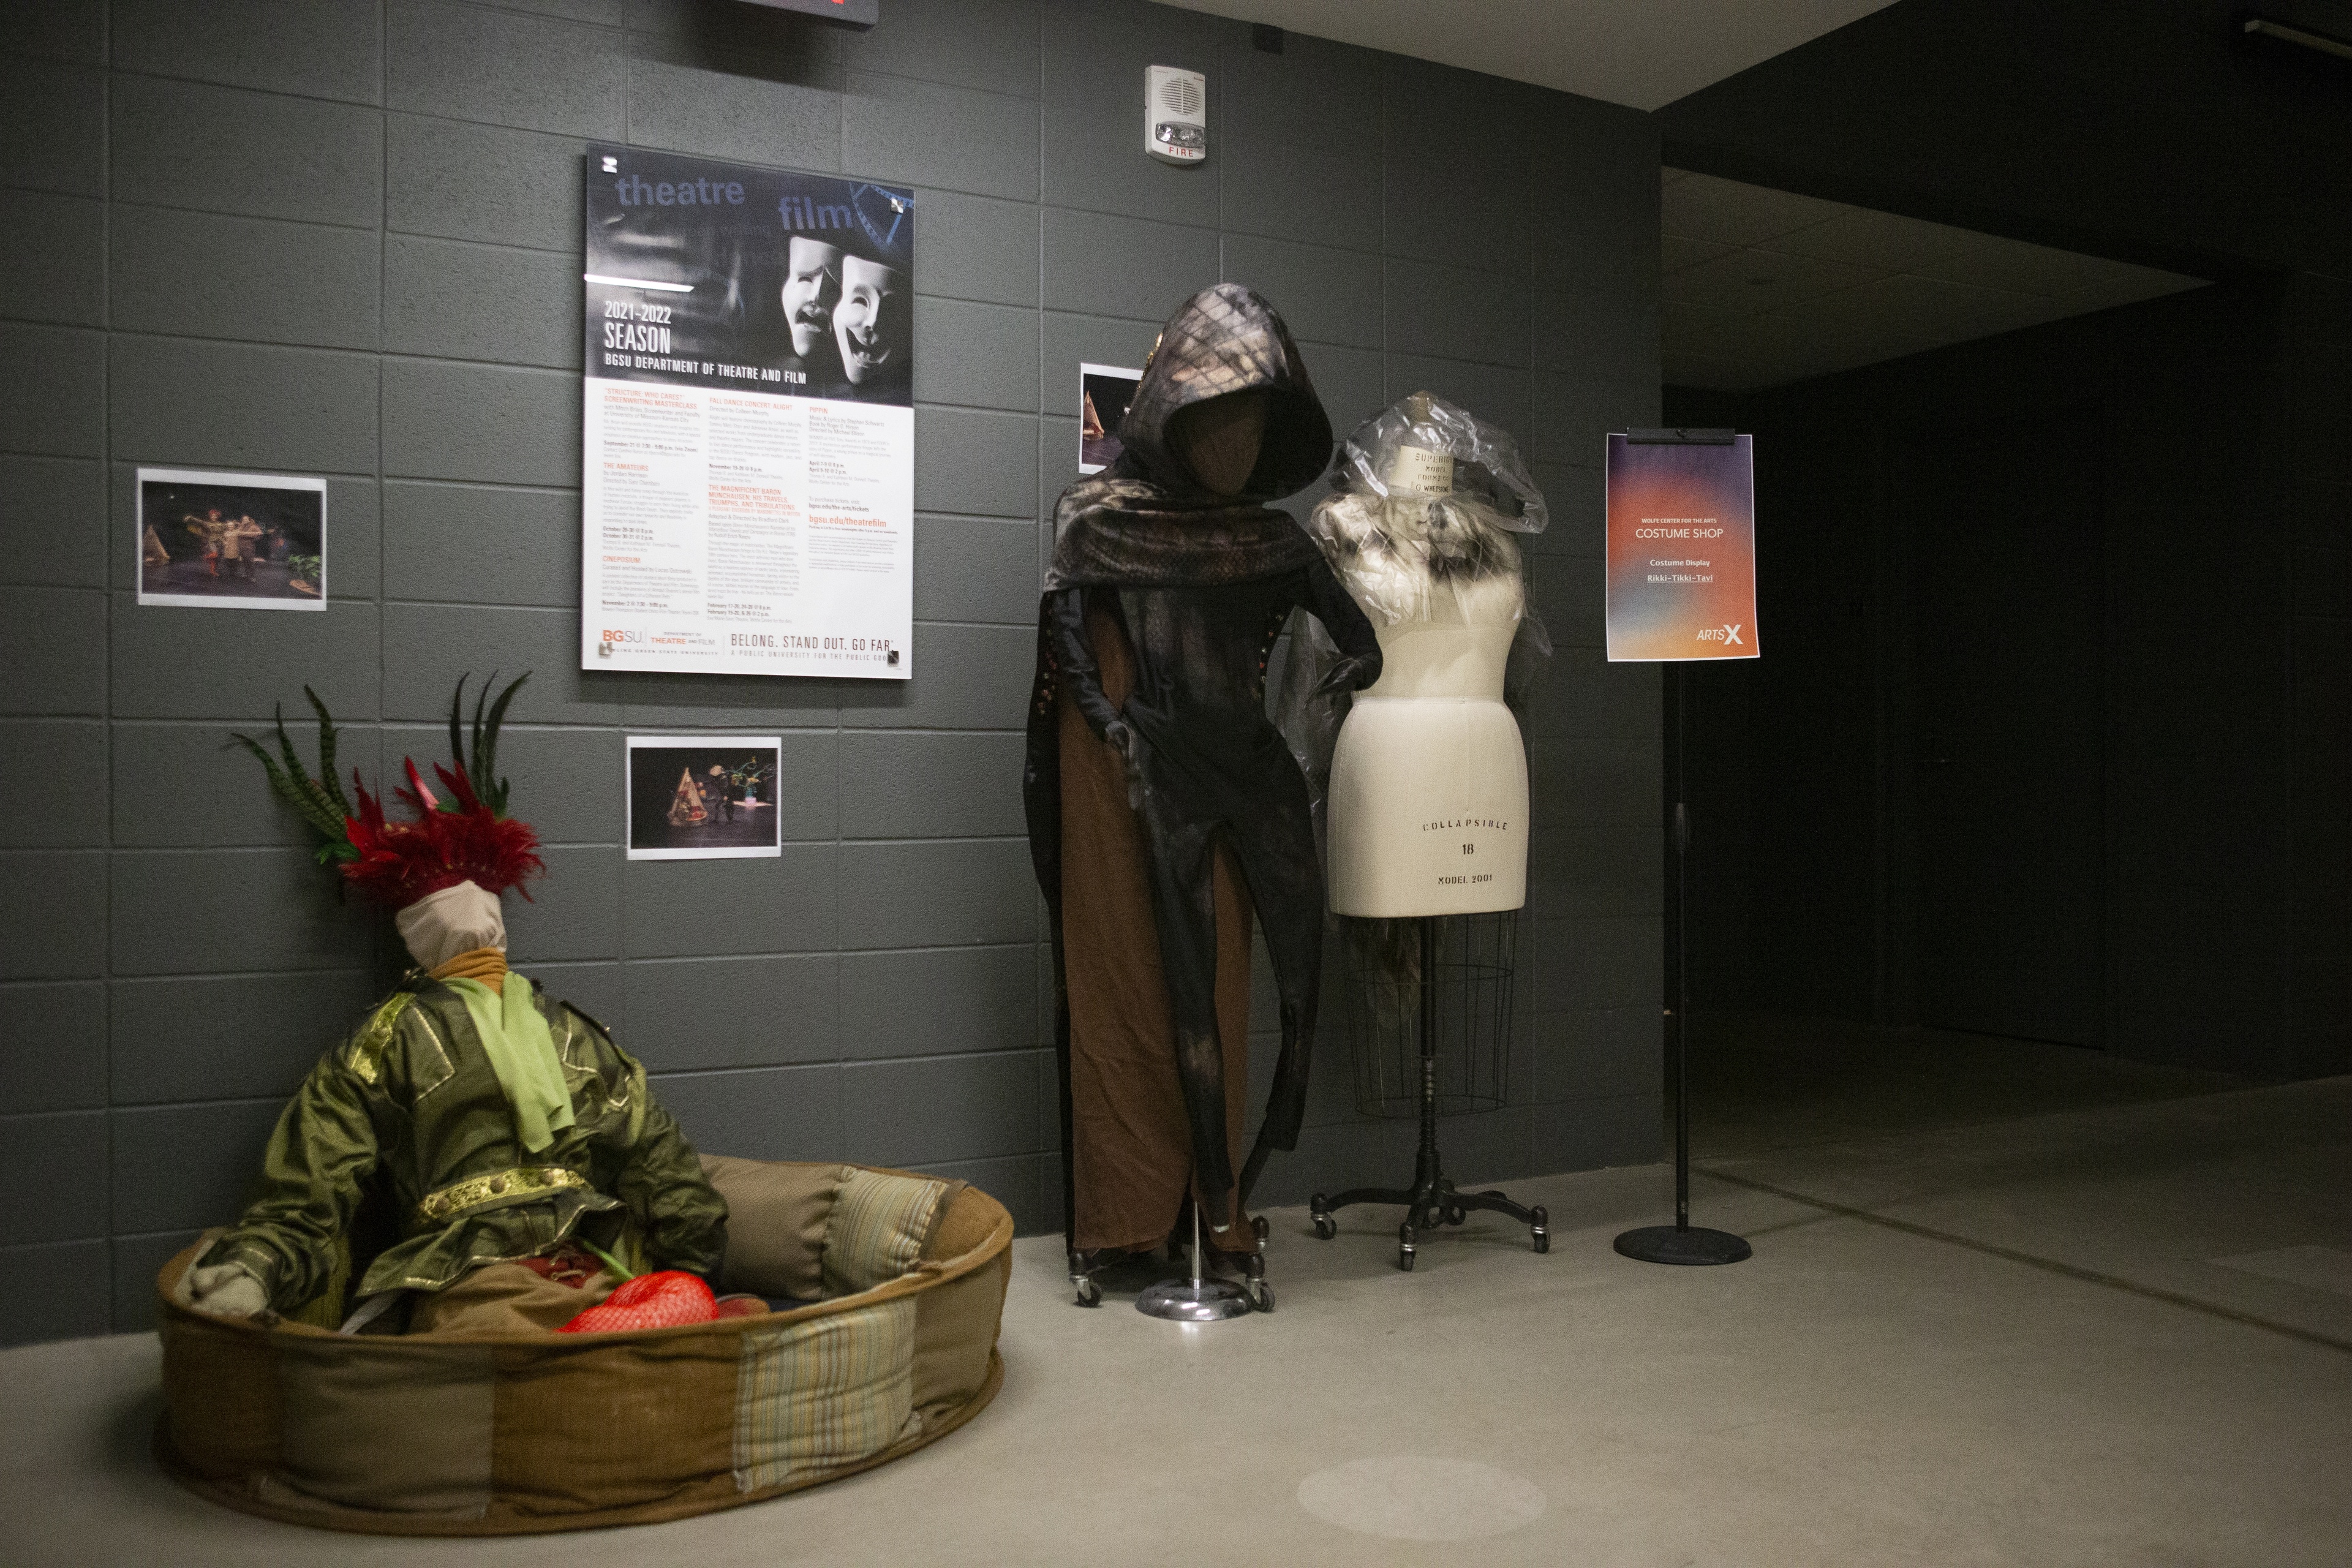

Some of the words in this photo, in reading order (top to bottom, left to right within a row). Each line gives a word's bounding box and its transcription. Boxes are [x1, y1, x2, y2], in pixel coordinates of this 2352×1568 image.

[1169, 146, 1194, 157] FIRE
[616, 175, 745, 206] theatre
[779, 197, 853, 230] film
[605, 301, 671, 324] 2021-2022
[605, 323, 670, 353] SEASON
[605, 353, 631, 368] BGSU
[635, 356, 698, 374] DEPARTMENT
[703, 363, 715, 375] OF
[718, 364, 758, 380] THEATRE
[762, 369, 781, 382] AND
[785, 371, 806, 385] FILM
[604, 396, 653, 405] SCREENWRITING
[655, 400, 697, 409] MASTERCLASS
[809, 503, 869, 513] bgsu.edu/the-arts/tickets
[809, 514, 886, 529] bgsu.edu/theatrefilm
[1636, 529, 1690, 538] COSTUME
[1693, 529, 1724, 538] SHOP
[731, 633, 778, 647] BELONG.
[783, 636, 818, 649] STAND
[824, 638, 847, 650] OUT.
[852, 639, 865, 650] GO
[1423, 819, 1507, 831] COLLAPSIBLE
[1463, 843, 1474, 854] 18
[1438, 875, 1468, 884] MODEL
[1472, 874, 1492, 883] 2001
